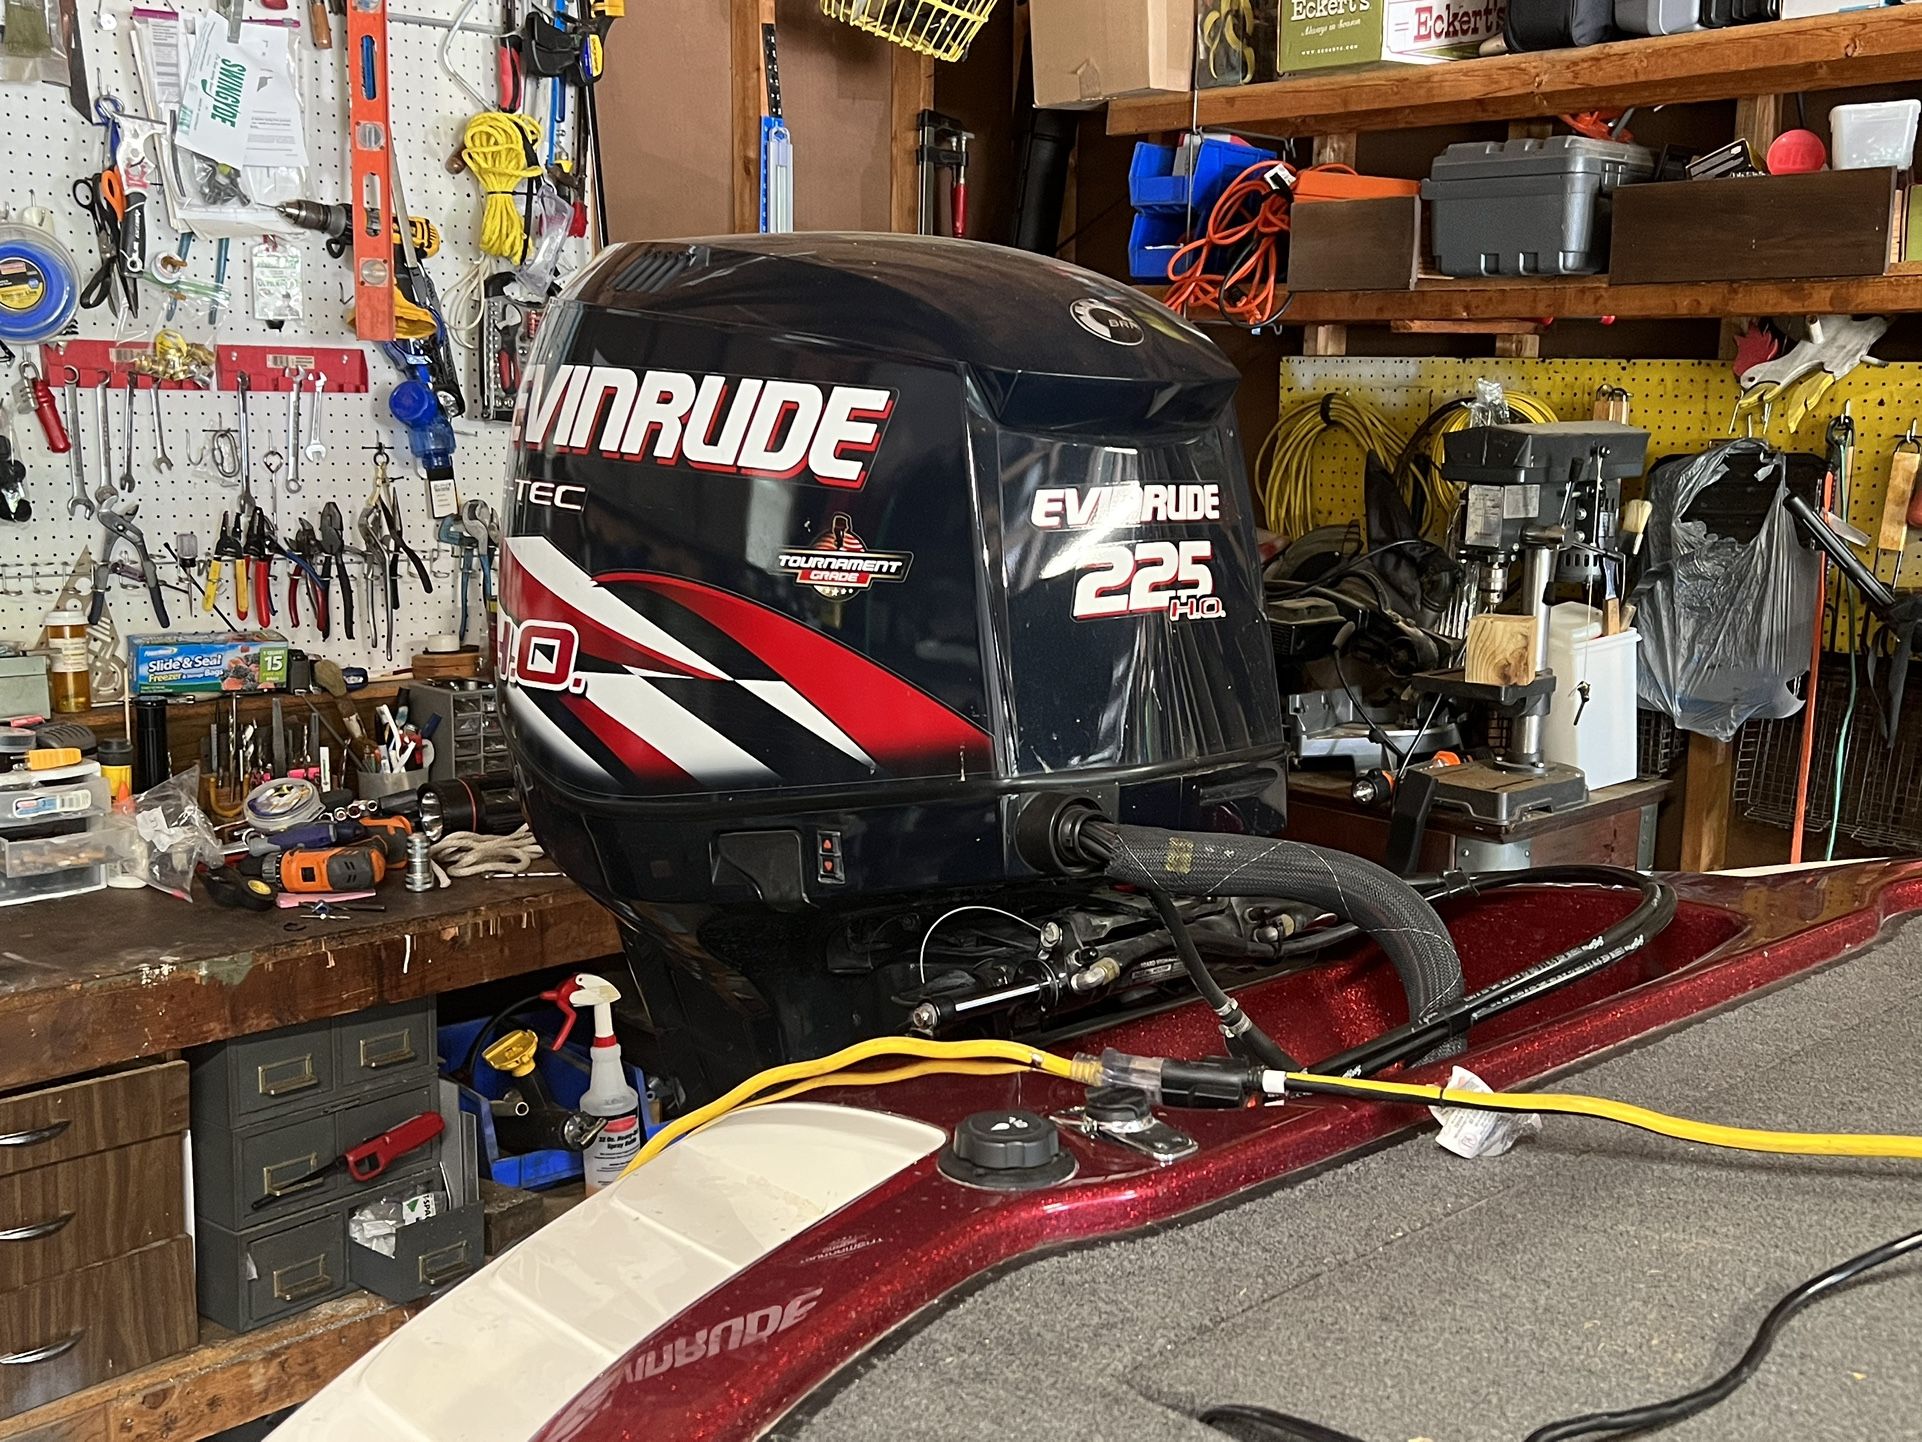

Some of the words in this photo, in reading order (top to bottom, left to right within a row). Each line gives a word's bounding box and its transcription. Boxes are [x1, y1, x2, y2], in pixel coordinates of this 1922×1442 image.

[778, 555, 902, 573] TOURNAMENT
[810, 570, 860, 582] GRADE
[1073, 541, 1214, 620] 225
[1169, 597, 1226, 621] H.O.
[148, 658, 180, 673] Slide
[182, 657, 192, 668] &
[194, 654, 222, 668] Seal
[265, 655, 283, 671] 15
[148, 673, 181, 682] Freezer
[204, 668, 224, 678] Bags
